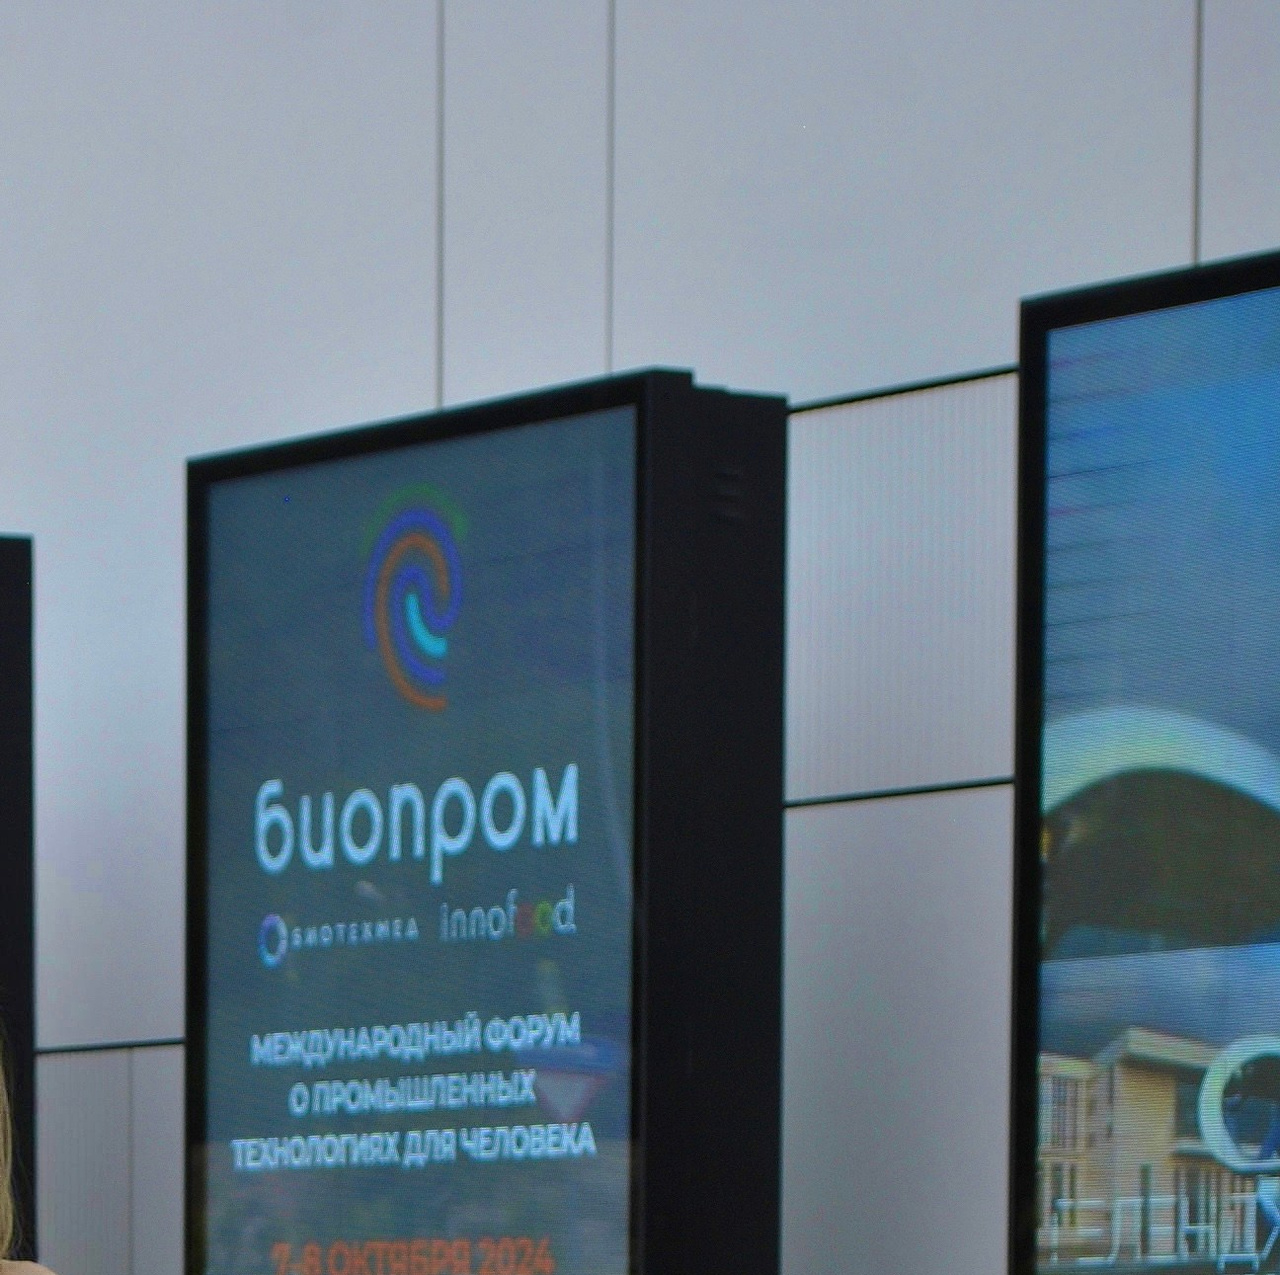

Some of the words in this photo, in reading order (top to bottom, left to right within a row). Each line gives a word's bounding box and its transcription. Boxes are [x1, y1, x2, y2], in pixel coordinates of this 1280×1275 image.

[254, 762, 580, 886] биопром
[250, 1011, 482, 1070] МЕЖДУНАРОДНЫЙ
[484, 1011, 582, 1051] ФОРУМ
[288, 1080, 310, 1117] О
[312, 1069, 537, 1116] ПРОМЫШЛЕННЫХ
[231, 1131, 401, 1171] ТЕХНОЛОГИЯХ
[402, 1128, 458, 1170] ДЛЯ
[459, 1121, 598, 1163] ЧЕЛОВЕКА
